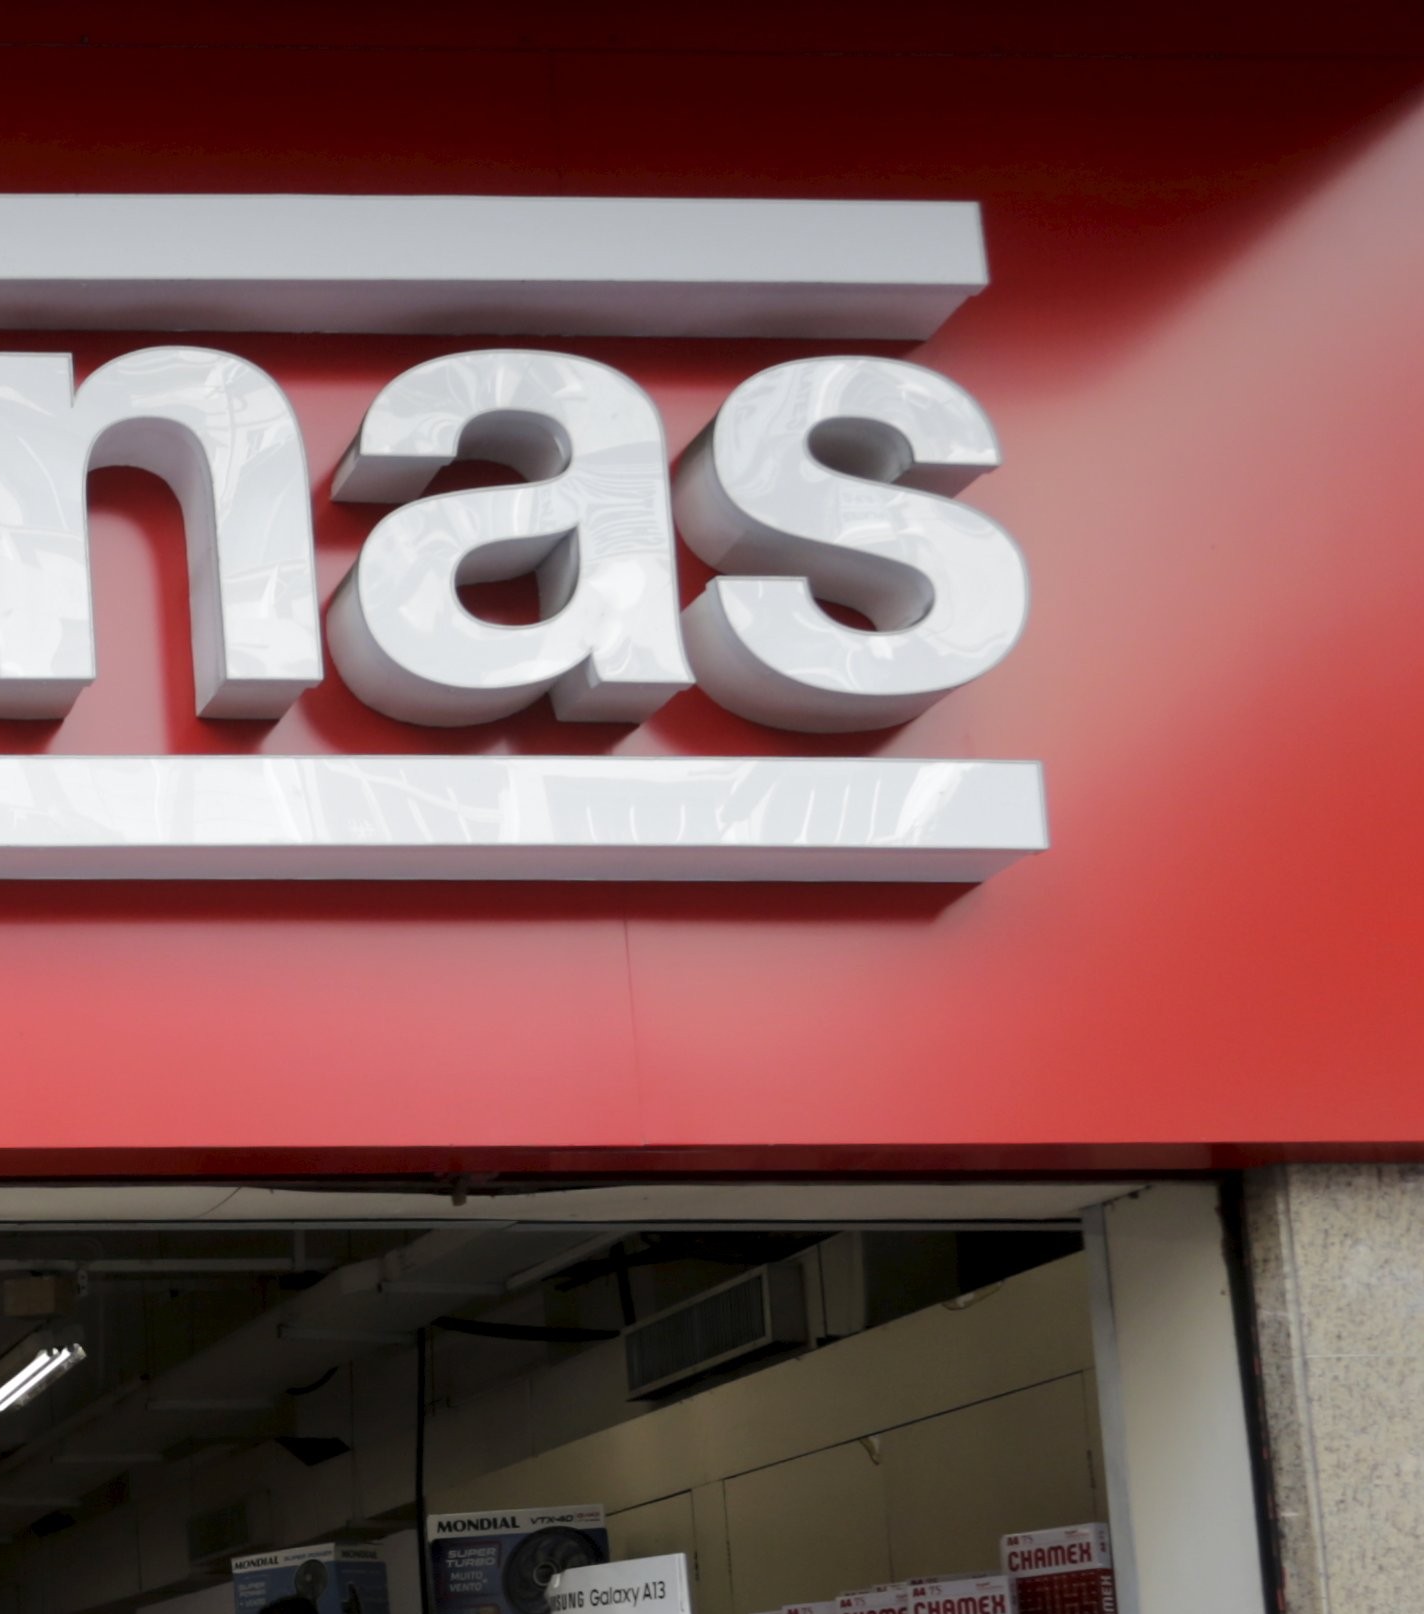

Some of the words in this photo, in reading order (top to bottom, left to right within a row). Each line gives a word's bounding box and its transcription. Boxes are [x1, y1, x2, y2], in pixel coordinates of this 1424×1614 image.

[437, 1516, 520, 1533] MONDIAL
[1007, 1536, 1020, 1546] A4
[447, 1547, 497, 1559] SUPER
[1007, 1541, 1092, 1572] CHAMEX
[235, 1556, 279, 1570] MONDIAL
[445, 1557, 497, 1568] TURBO
[450, 1570, 484, 1581] MUITO
[589, 1581, 641, 1608] Galaxy
[642, 1581, 666, 1602] A13
[913, 1587, 926, 1597] A4
[840, 1598, 853, 1608] A4
